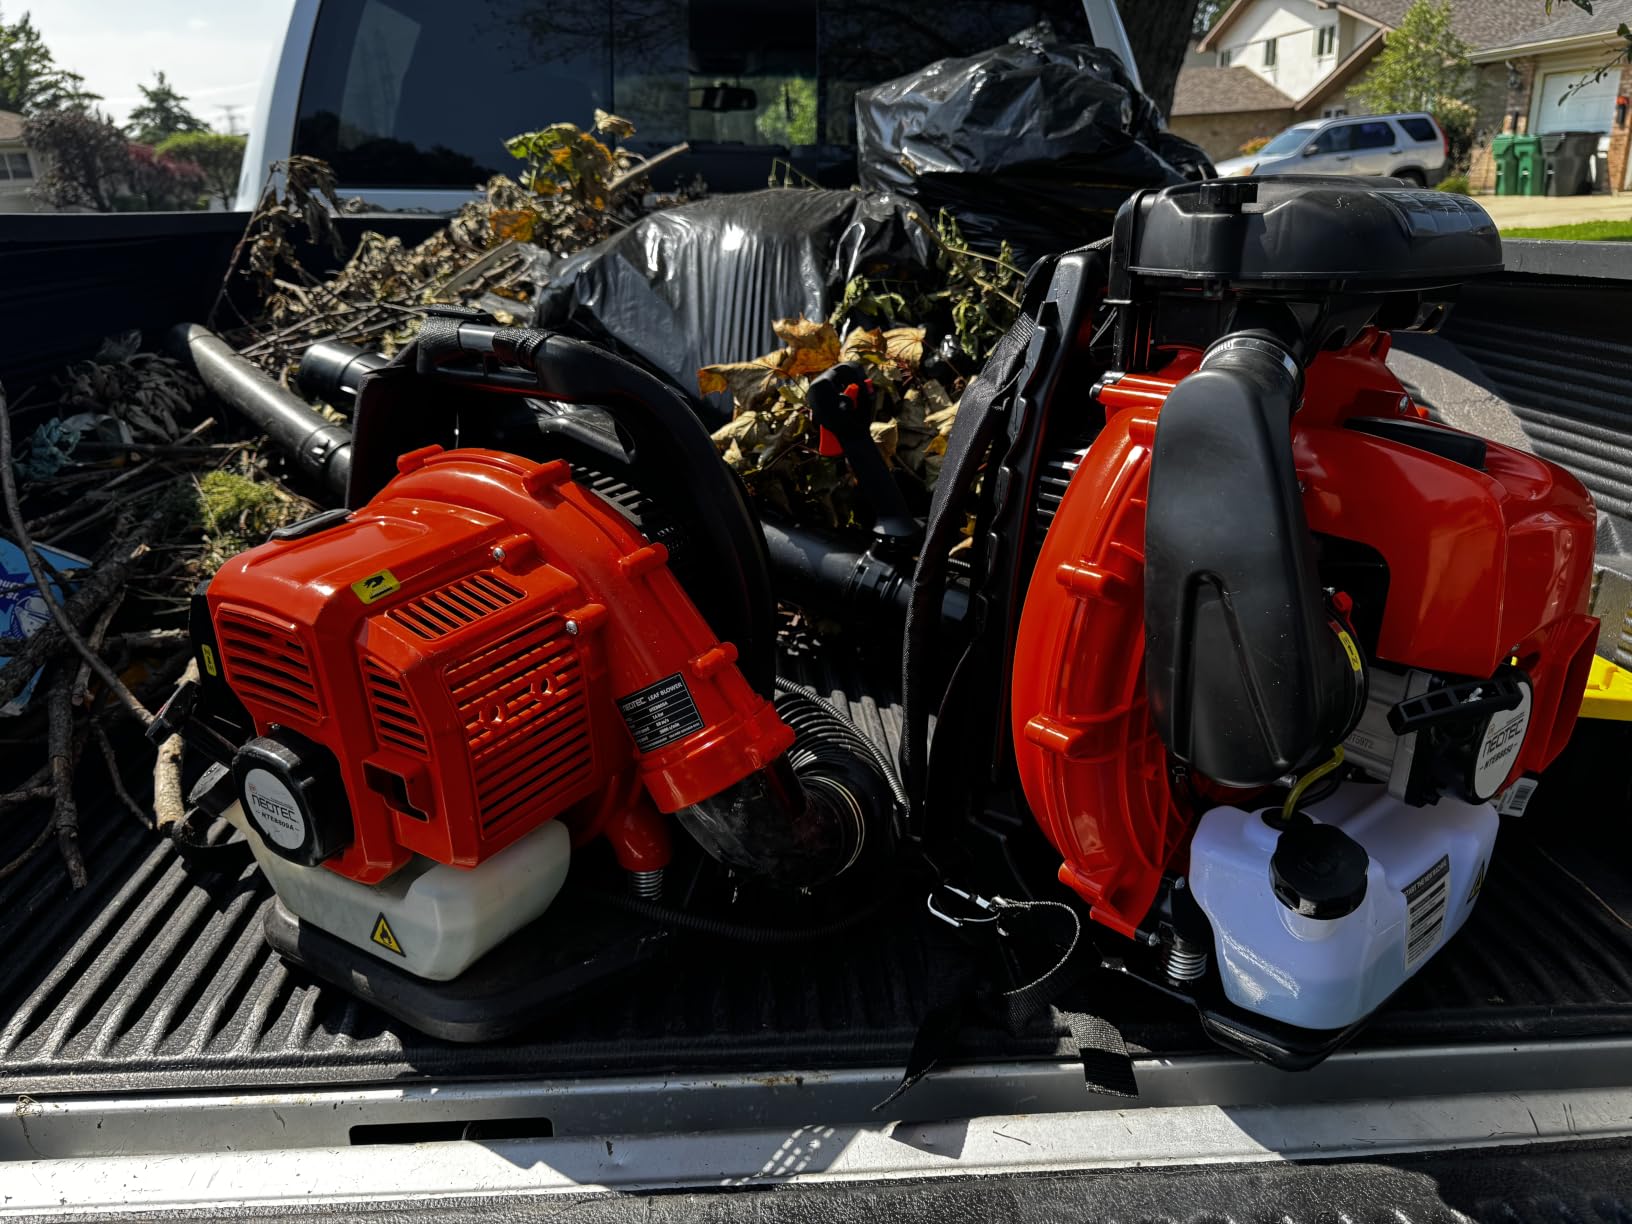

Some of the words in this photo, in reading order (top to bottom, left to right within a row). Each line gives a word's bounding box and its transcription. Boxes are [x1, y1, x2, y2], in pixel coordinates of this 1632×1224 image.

[648, 691, 660, 701] LEAF
[660, 682, 683, 696] BLOWER
[1482, 718, 1523, 758] NEOTEC
[251, 794, 297, 823] NEOTEC
